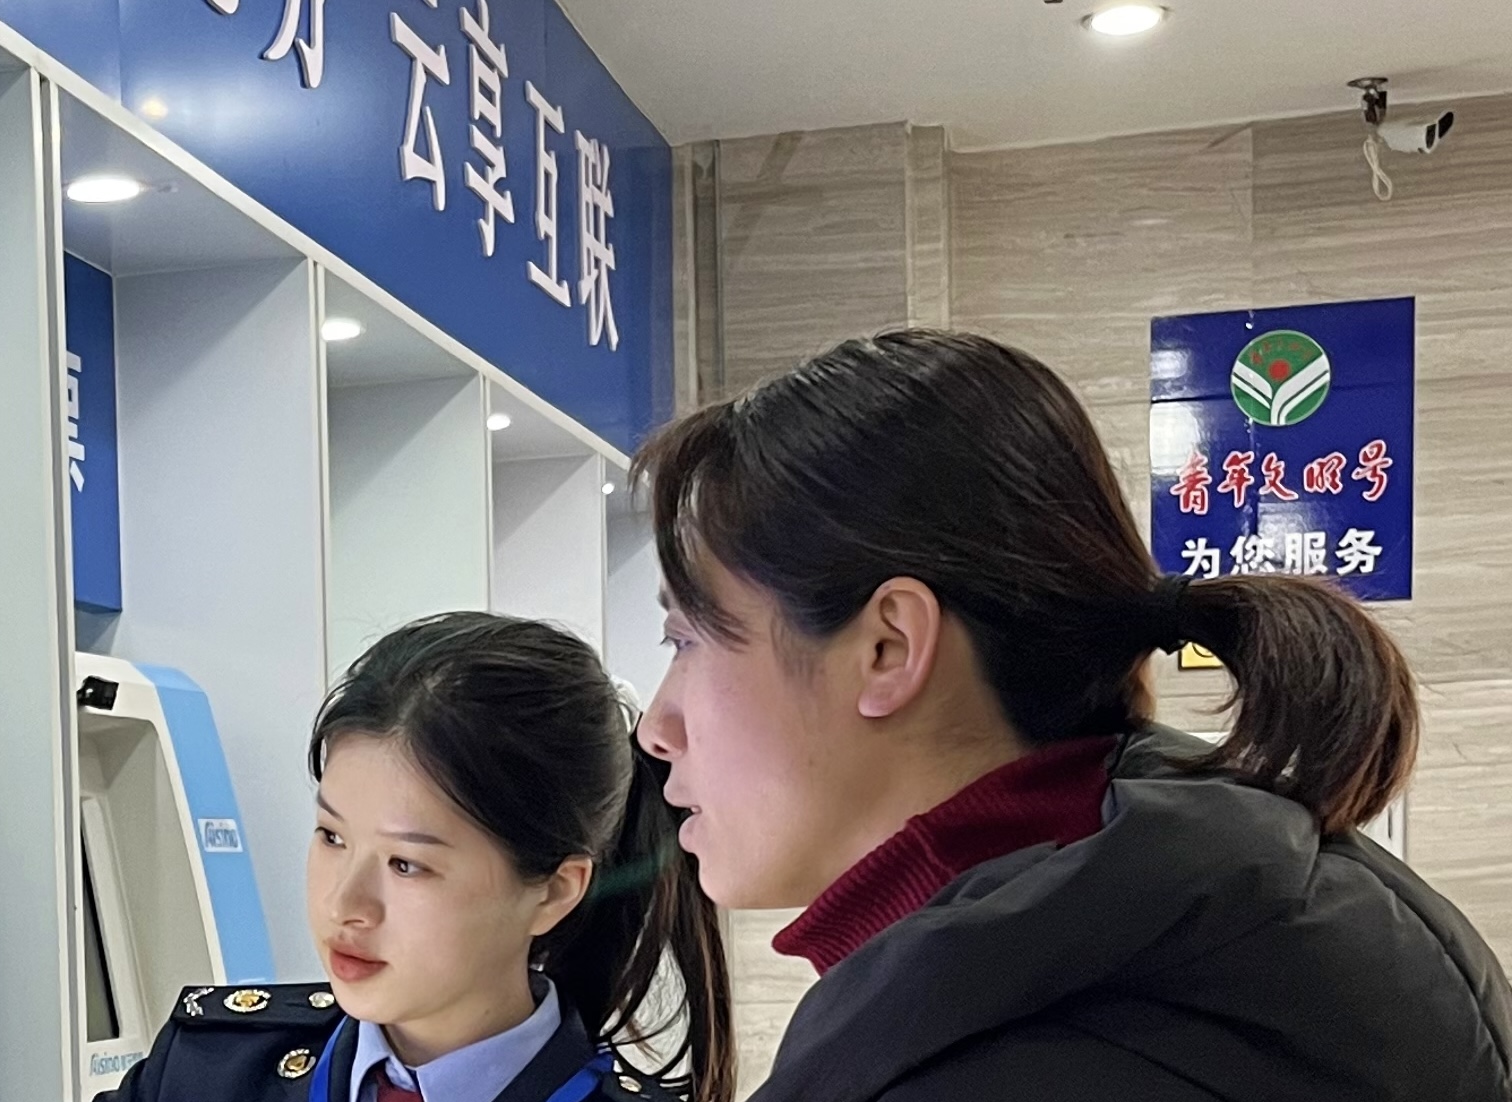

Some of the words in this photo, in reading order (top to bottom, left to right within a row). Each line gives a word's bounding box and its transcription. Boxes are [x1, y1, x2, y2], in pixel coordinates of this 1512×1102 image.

[1170, 439, 1393, 515] 青年文明号
[1180, 528, 1383, 580] 为您服务
